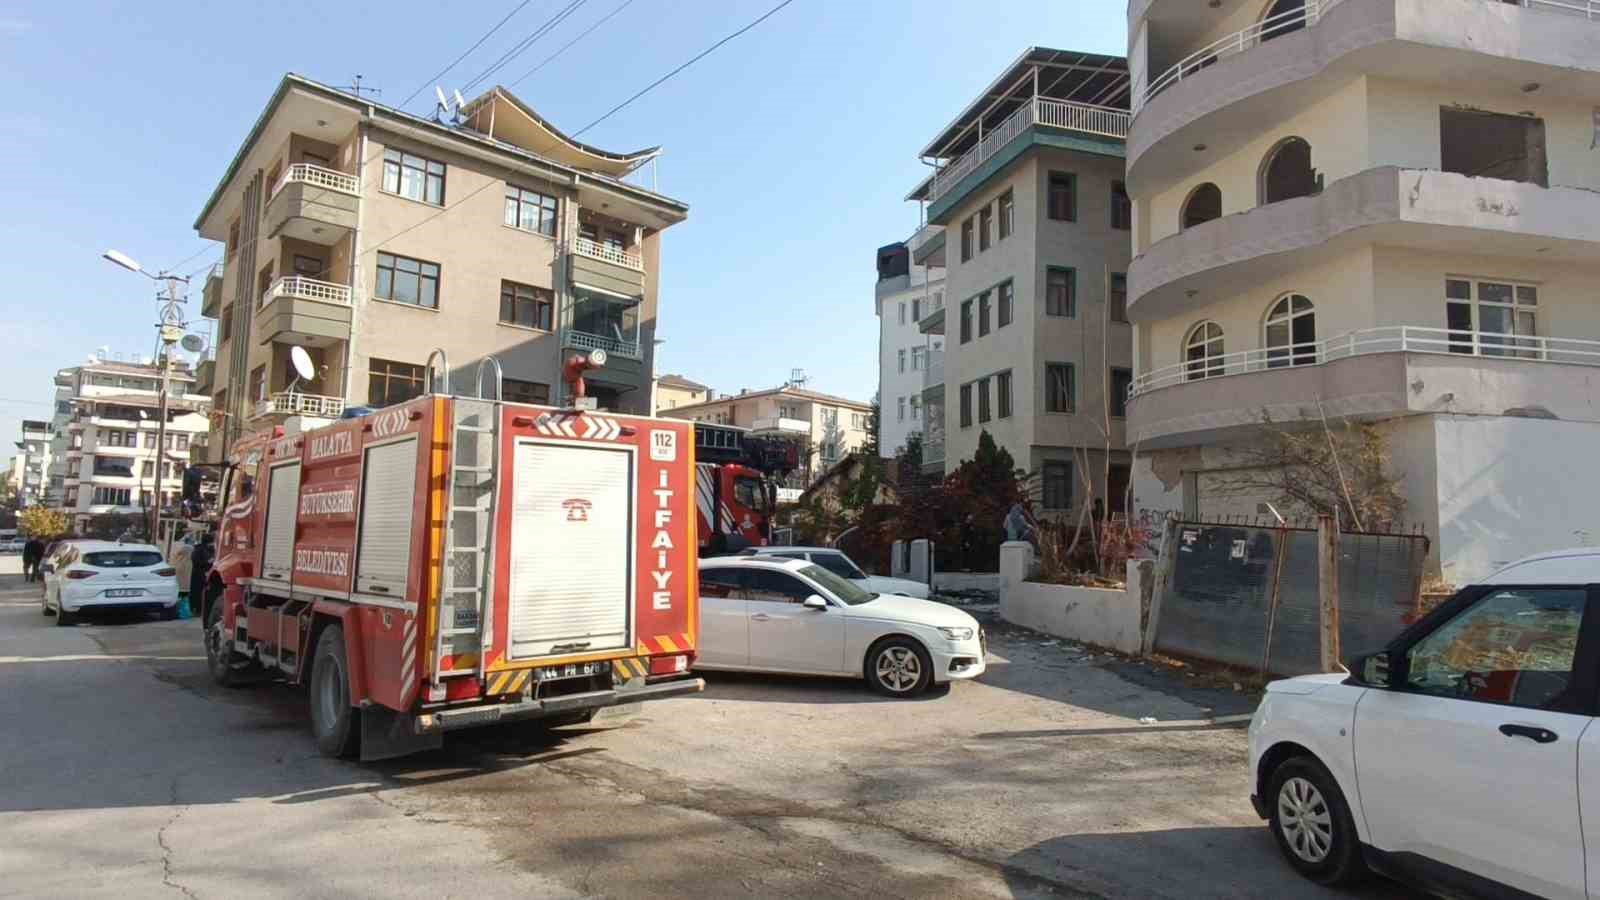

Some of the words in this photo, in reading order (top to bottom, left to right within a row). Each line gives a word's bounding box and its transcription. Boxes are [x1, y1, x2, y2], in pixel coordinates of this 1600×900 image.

[311, 431, 352, 458] MALATYA
[655, 433, 672, 447] 112
[651, 469, 674, 609] İTFAİYE
